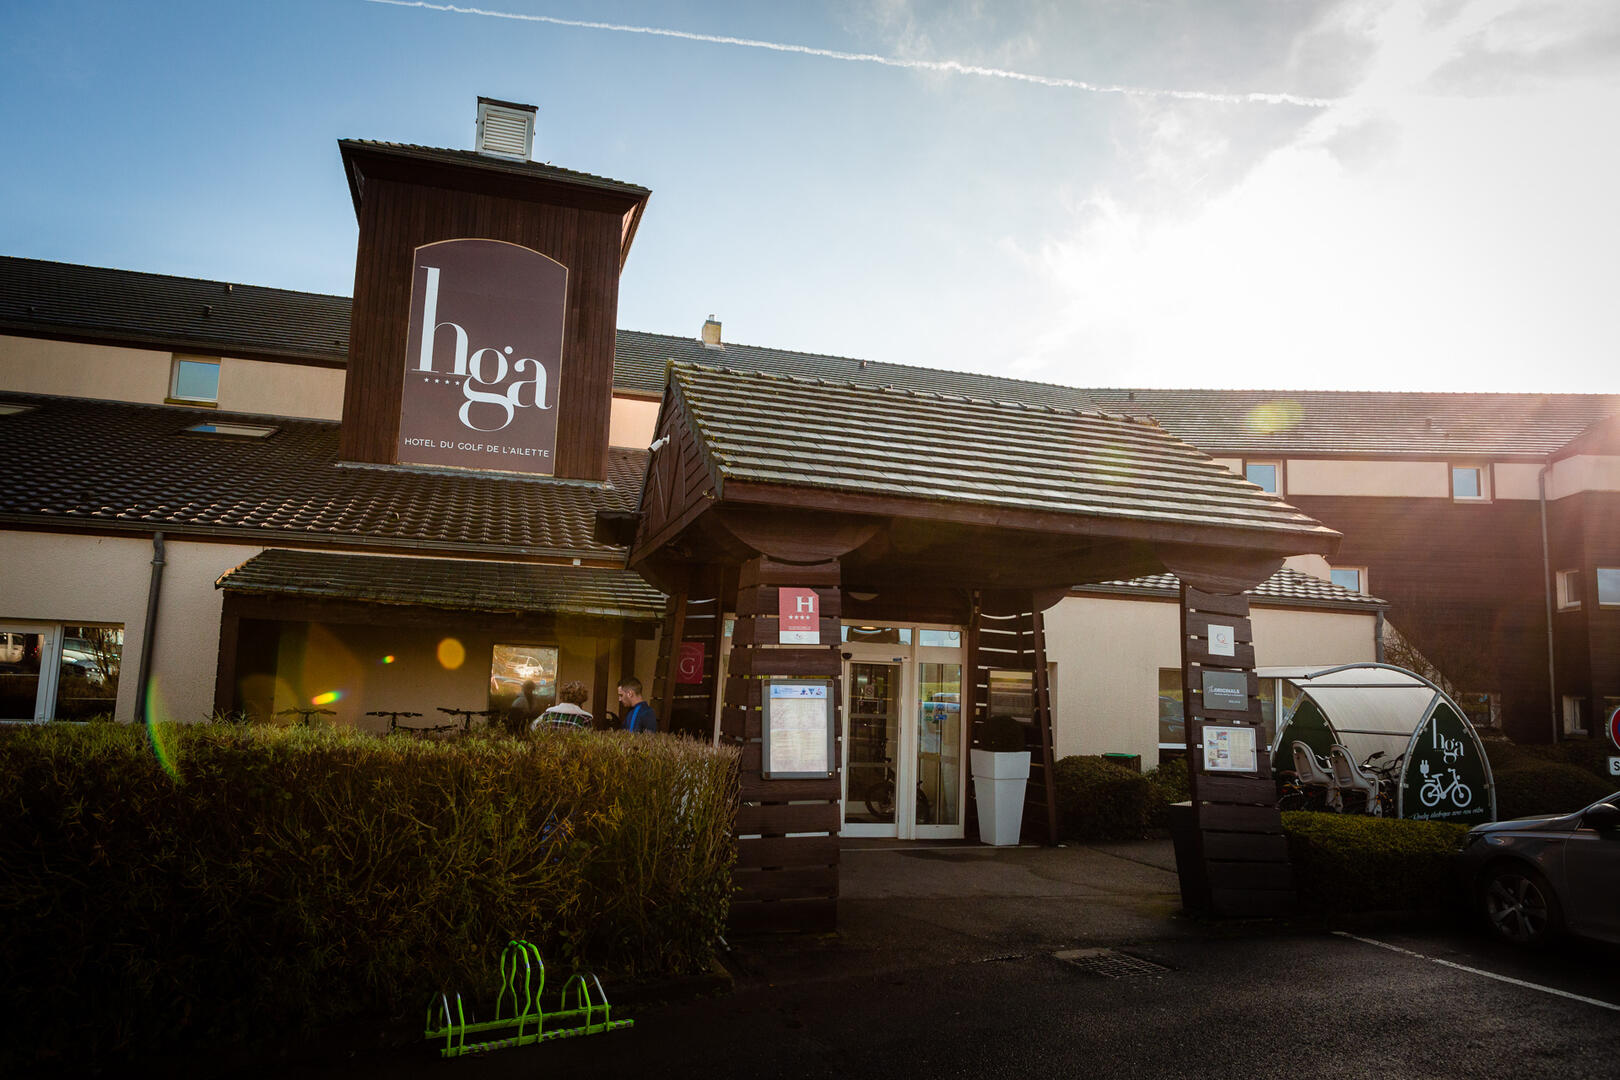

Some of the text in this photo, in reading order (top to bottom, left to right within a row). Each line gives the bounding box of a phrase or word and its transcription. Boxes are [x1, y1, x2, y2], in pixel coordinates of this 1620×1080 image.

[411, 265, 552, 431] hga
[404, 437, 550, 458] HOTEL DU GOLF DE L'AILETTE
[796, 596, 815, 613] H
[680, 657, 695, 674] G
[1432, 718, 1464, 764] hga
